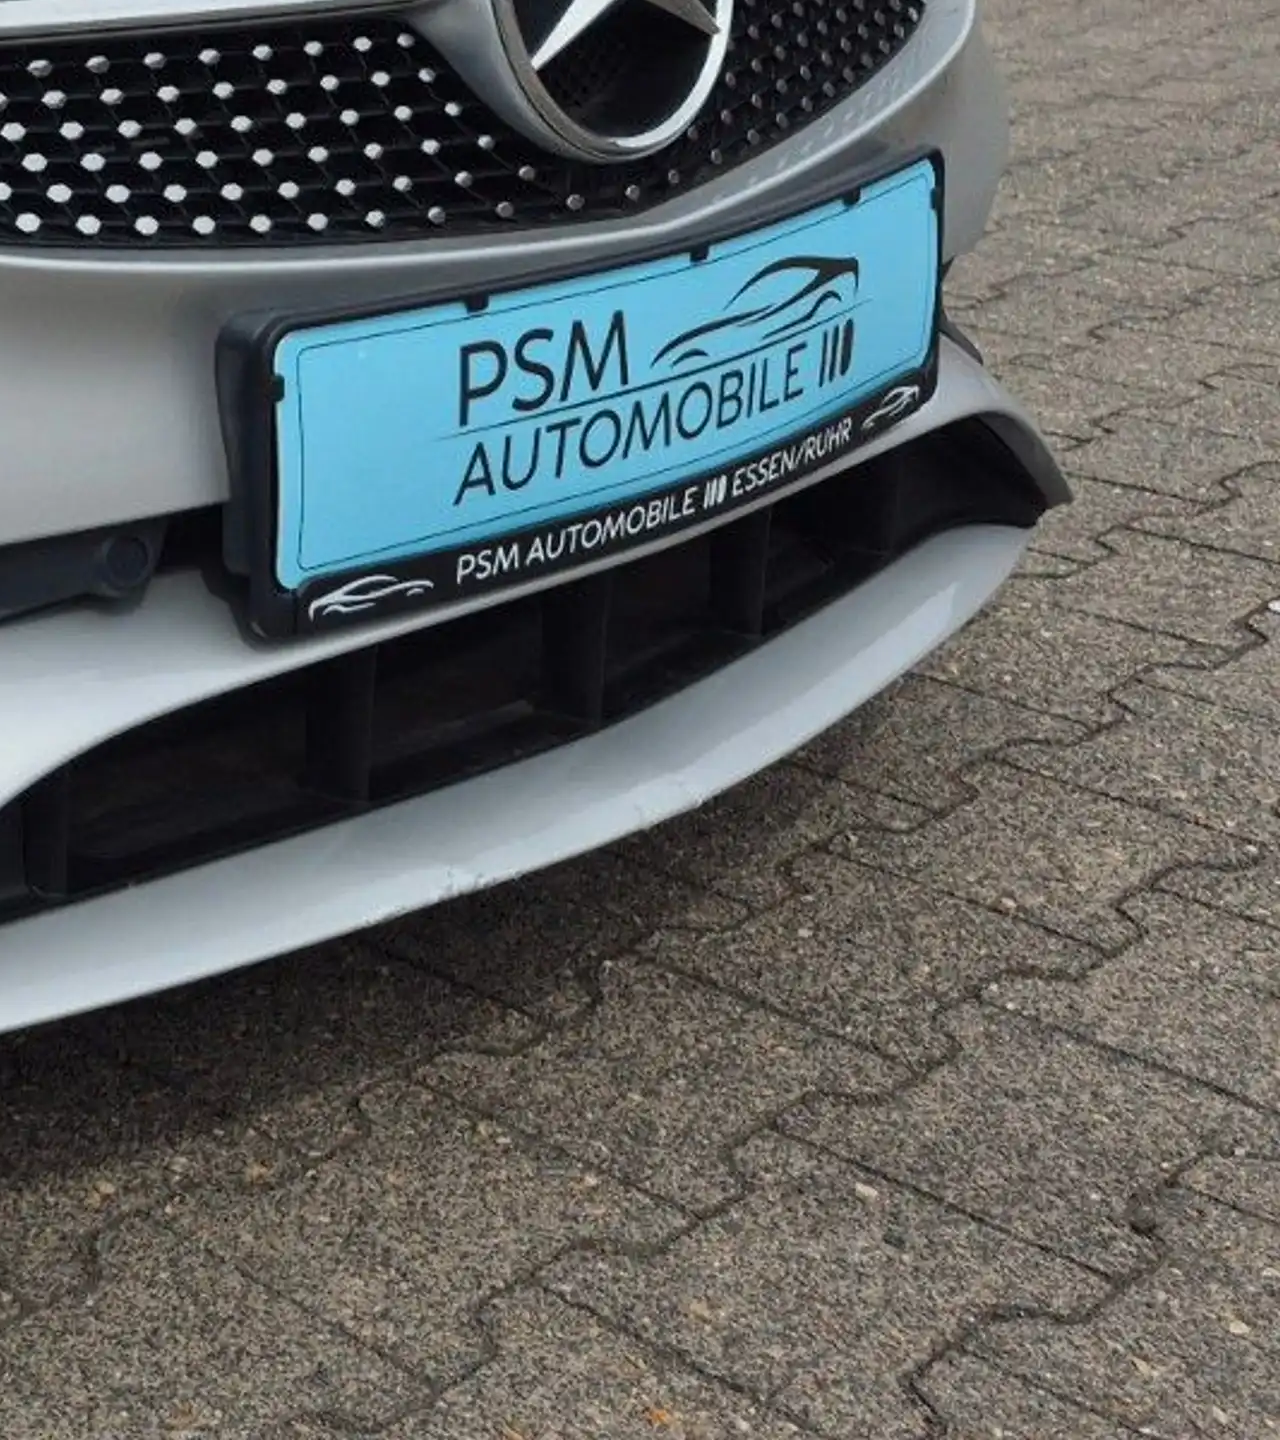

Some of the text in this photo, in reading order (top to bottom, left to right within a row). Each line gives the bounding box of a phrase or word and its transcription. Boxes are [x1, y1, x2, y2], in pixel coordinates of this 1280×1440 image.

[452, 340, 808, 507] AUTOMOBILE
[459, 309, 629, 427] PSM
[456, 416, 853, 585] PSM AUTOMOBILE ESSEN/RUHR
